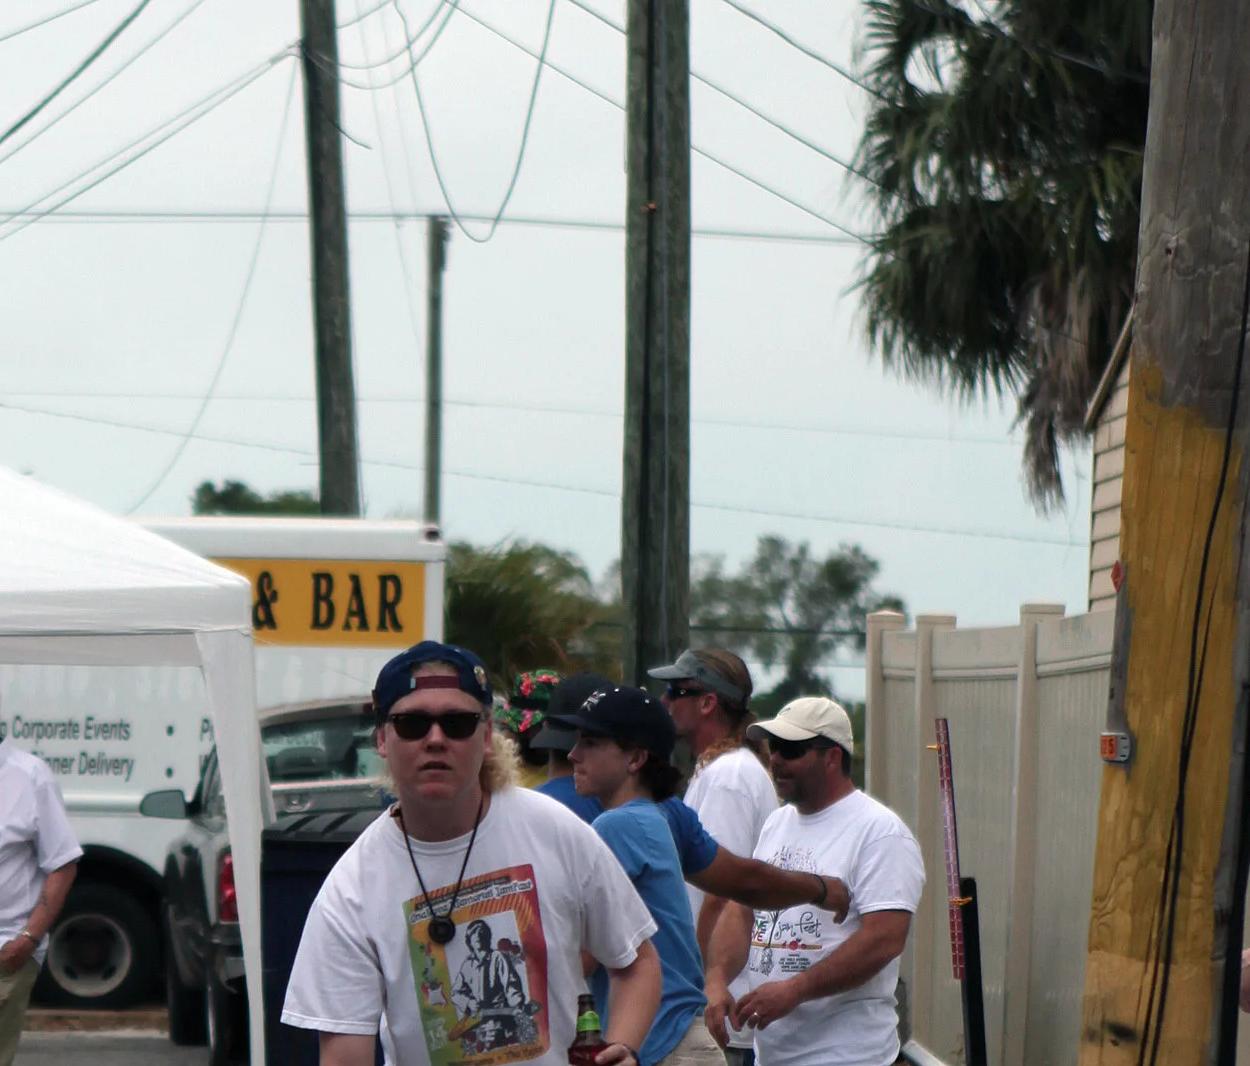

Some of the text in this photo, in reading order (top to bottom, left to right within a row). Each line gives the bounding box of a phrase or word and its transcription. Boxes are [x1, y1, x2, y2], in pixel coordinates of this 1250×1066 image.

[252, 571, 404, 633] & BAR
[12, 715, 79, 745] Corporate
[84, 716, 131, 741] Events
[78, 752, 134, 782] Delivery
